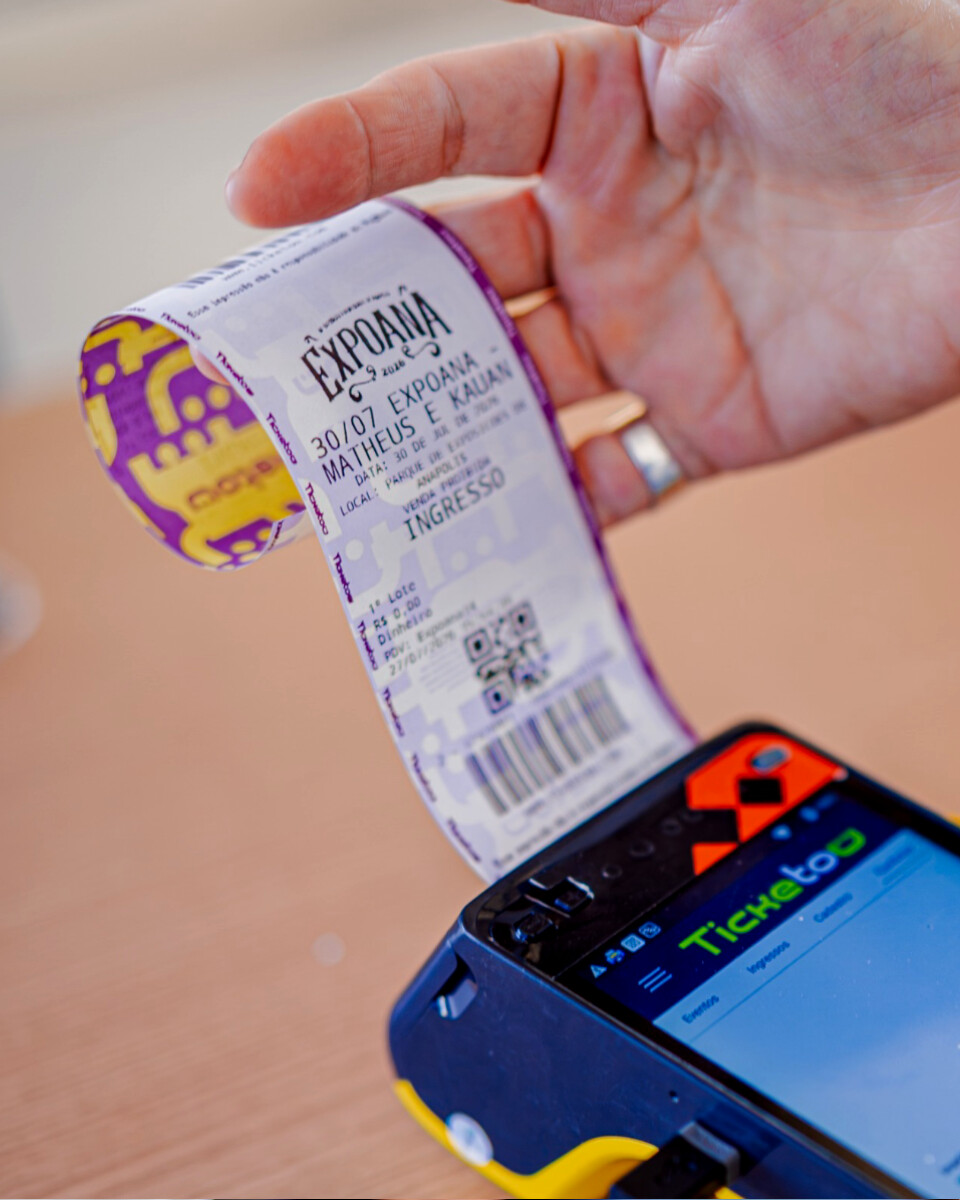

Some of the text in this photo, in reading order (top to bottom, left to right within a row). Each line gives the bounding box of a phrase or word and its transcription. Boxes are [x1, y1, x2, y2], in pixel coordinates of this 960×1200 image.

[301, 291, 453, 402] EXPOANA
[311, 405, 375, 458] 30/07
[387, 352, 476, 414] EXPOANA
[321, 363, 512, 483] MATHEUS E KAUAN
[339, 488, 379, 516] LOCAL:
[385, 460, 423, 488] PARQUE
[428, 450, 441, 464] DE
[353, 460, 388, 486] DATA:
[395, 448, 408, 462] 30
[411, 439, 425, 452] DE
[402, 490, 435, 513] VENDA
[403, 467, 504, 540] INGRESSO
[372, 615, 387, 629] R$
[376, 608, 432, 646] Dinheiro
[681, 994, 719, 1023] Eventos
[746, 940, 790, 974] Ingressos
